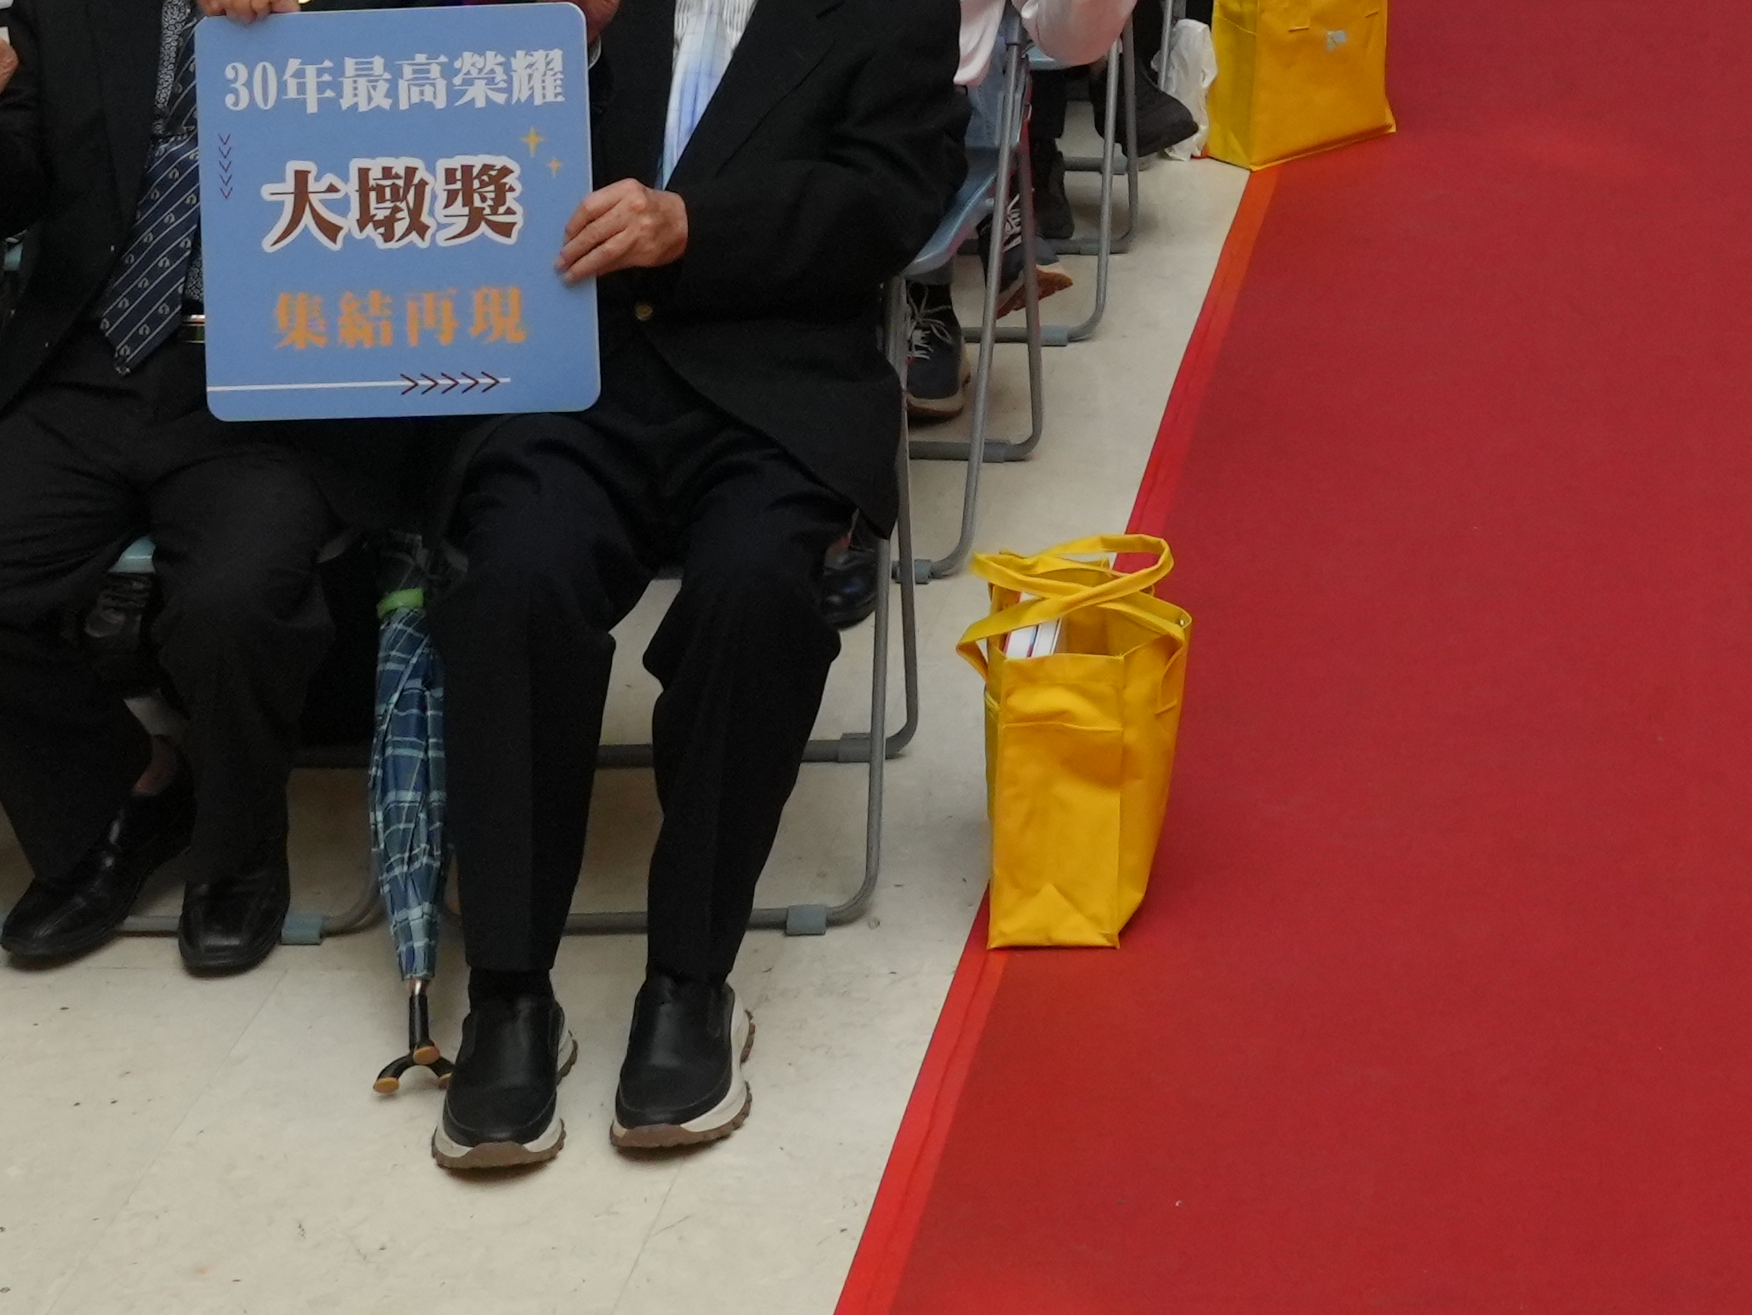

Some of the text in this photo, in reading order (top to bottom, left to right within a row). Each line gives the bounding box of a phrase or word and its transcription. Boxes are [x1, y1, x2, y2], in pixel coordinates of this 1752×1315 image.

[224, 48, 565, 114] 30年最高榮耀
[261, 153, 525, 254] 大墩獎
[274, 287, 527, 349] 集結再現
